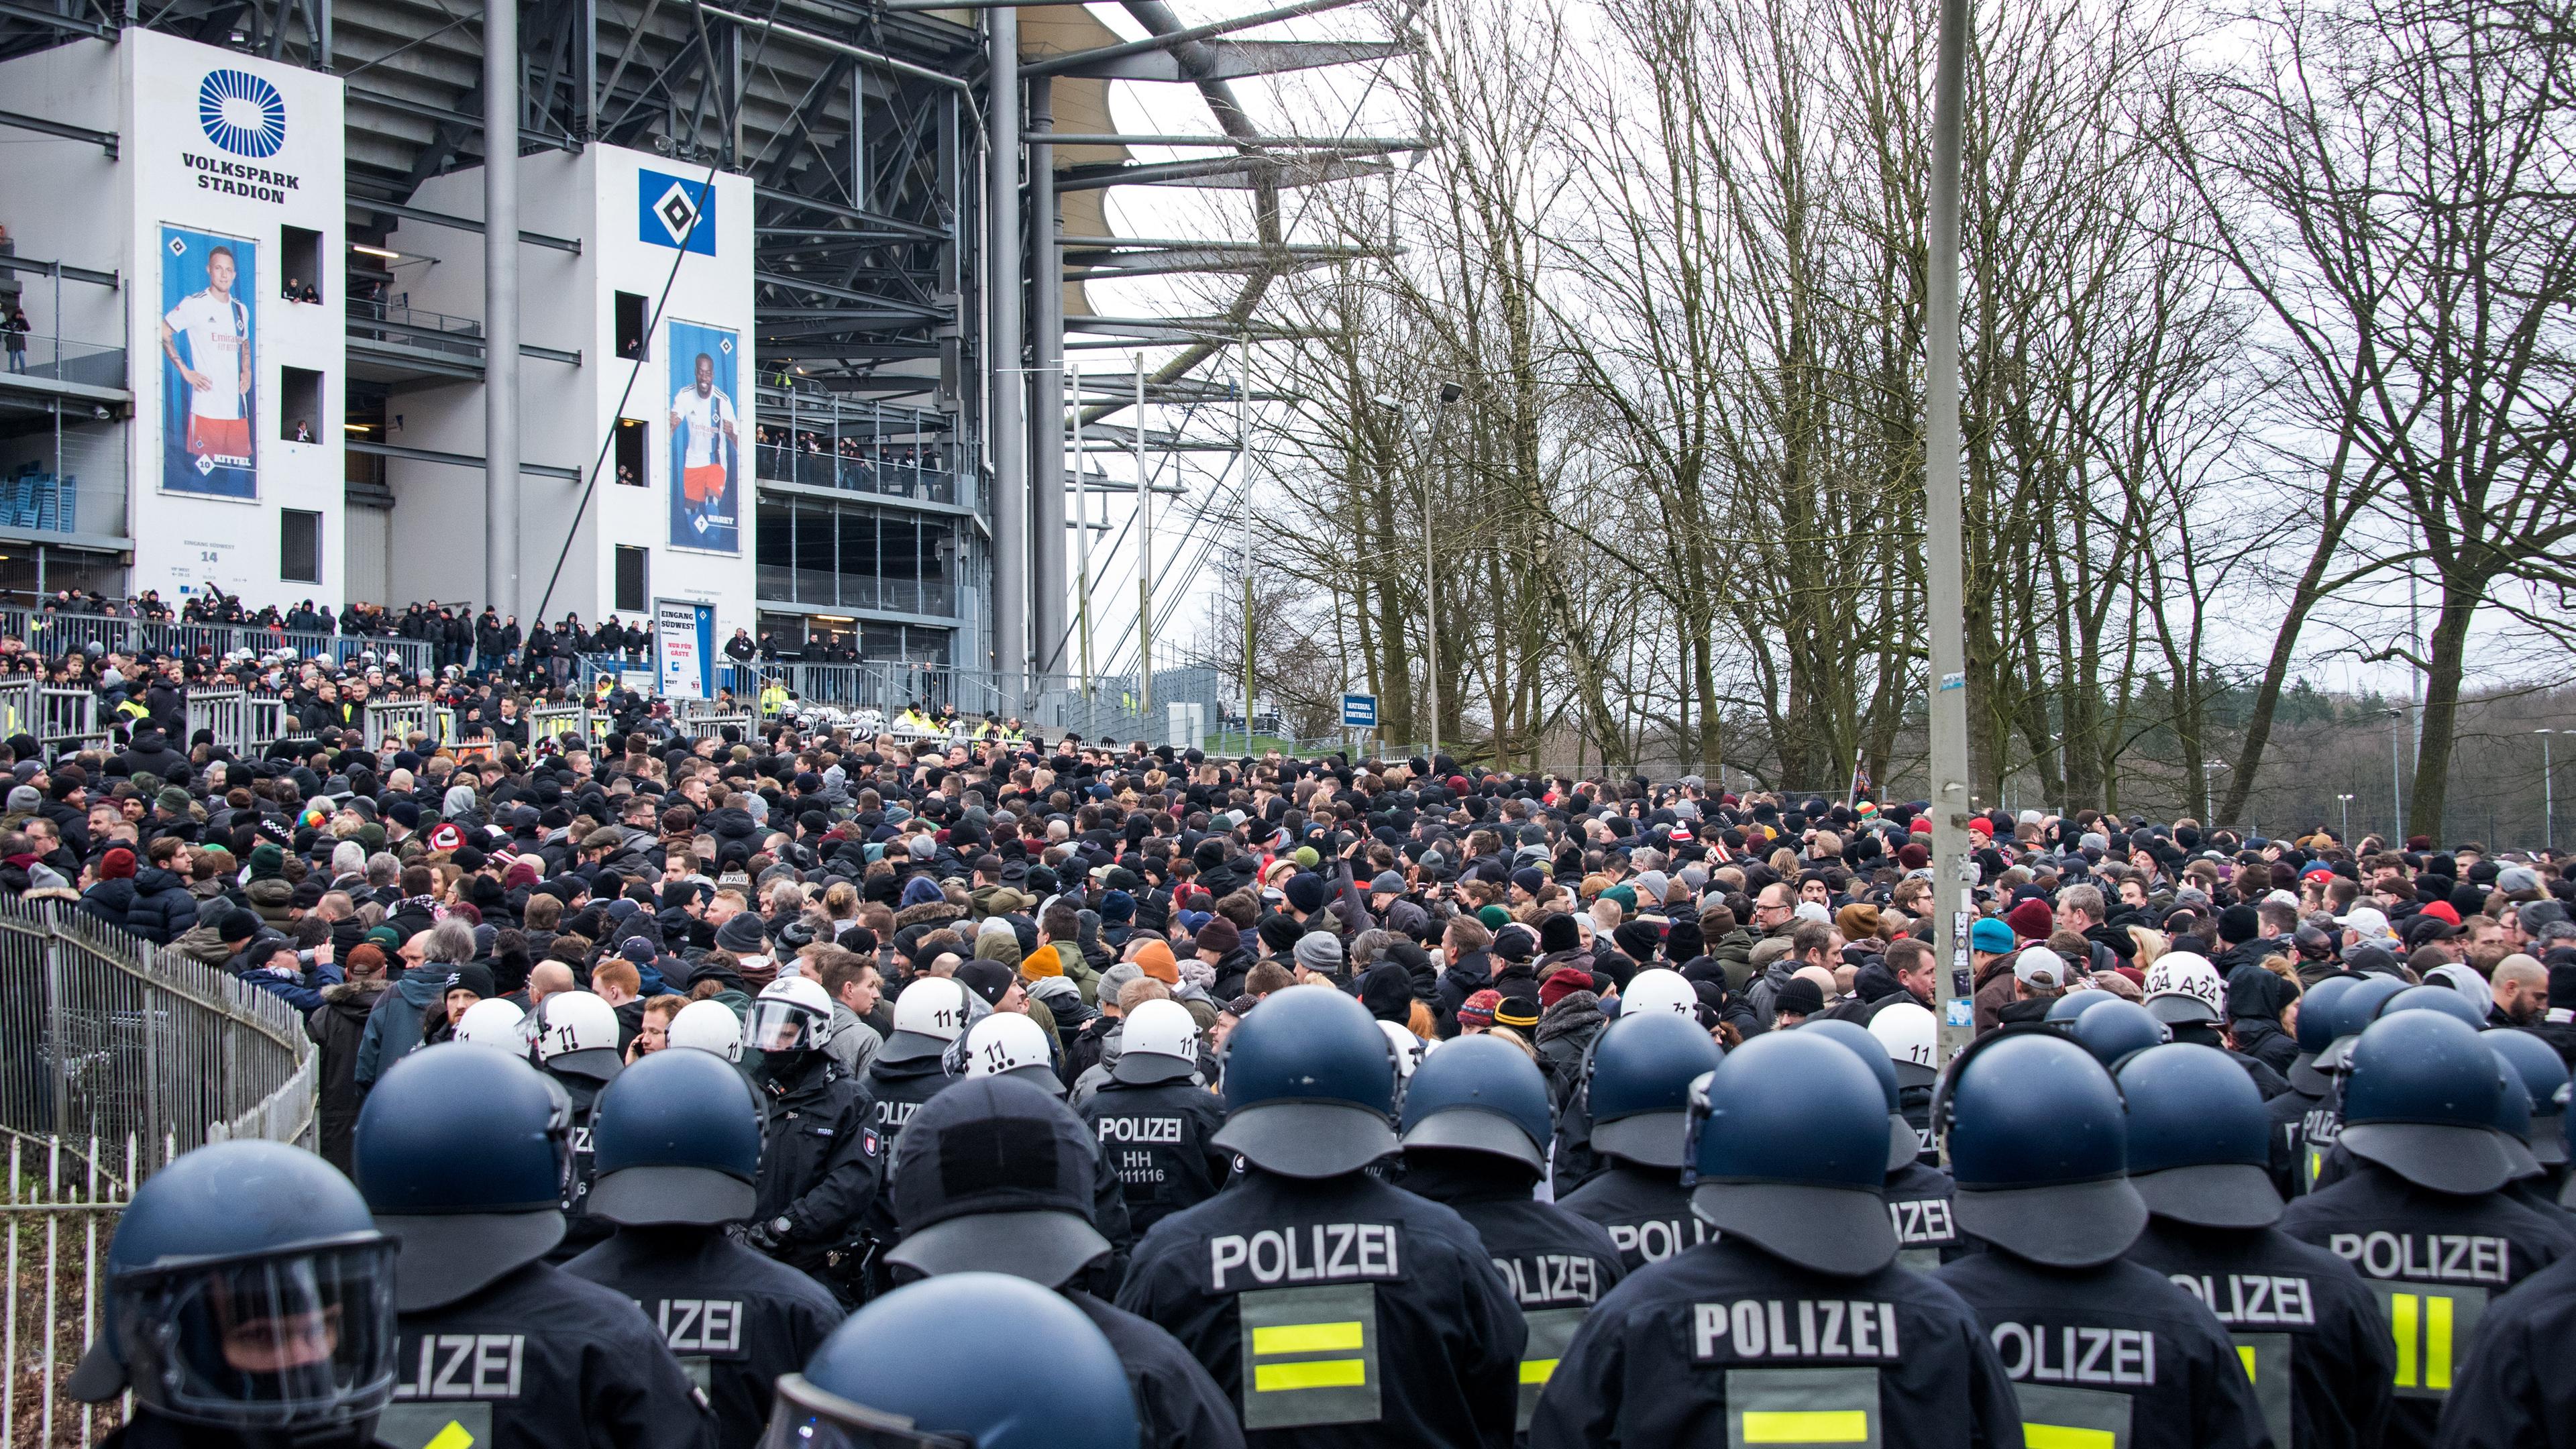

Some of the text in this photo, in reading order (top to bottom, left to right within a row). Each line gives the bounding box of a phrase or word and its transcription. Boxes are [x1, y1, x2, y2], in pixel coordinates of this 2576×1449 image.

[182, 152, 299, 190] VOLKSPARK
[197, 174, 284, 204] STADION
[213, 453, 251, 466] KITTEL
[201, 551, 218, 563] 14
[661, 610, 694, 621] EINGANG
[661, 619, 696, 631] SÜDWEST
[681, 642, 692, 650] FÜR
[1346, 710, 1373, 720] KONTROLLE
[1347, 702, 1371, 711] MATERIAL
[2178, 975, 2216, 1004] A24
[1673, 1002, 1686, 1015] 11
[934, 1009, 951, 1028] 11
[459, 1030, 470, 1043] 11
[557, 1024, 576, 1044] 11
[727, 1041, 738, 1061] 11
[984, 1040, 1006, 1063] 11
[1180, 1036, 1193, 1057] 11
[1910, 1044, 1930, 1065] 11
[1098, 1117, 1182, 1142] POLIZEI
[1123, 1150, 1152, 1167] HH
[1118, 1169, 1165, 1183] 111116
[1210, 1222, 1399, 1290] POLIZEI
[2330, 1230, 2509, 1283] POLIZEI
[1694, 1299, 1899, 1357] POLIZEI
